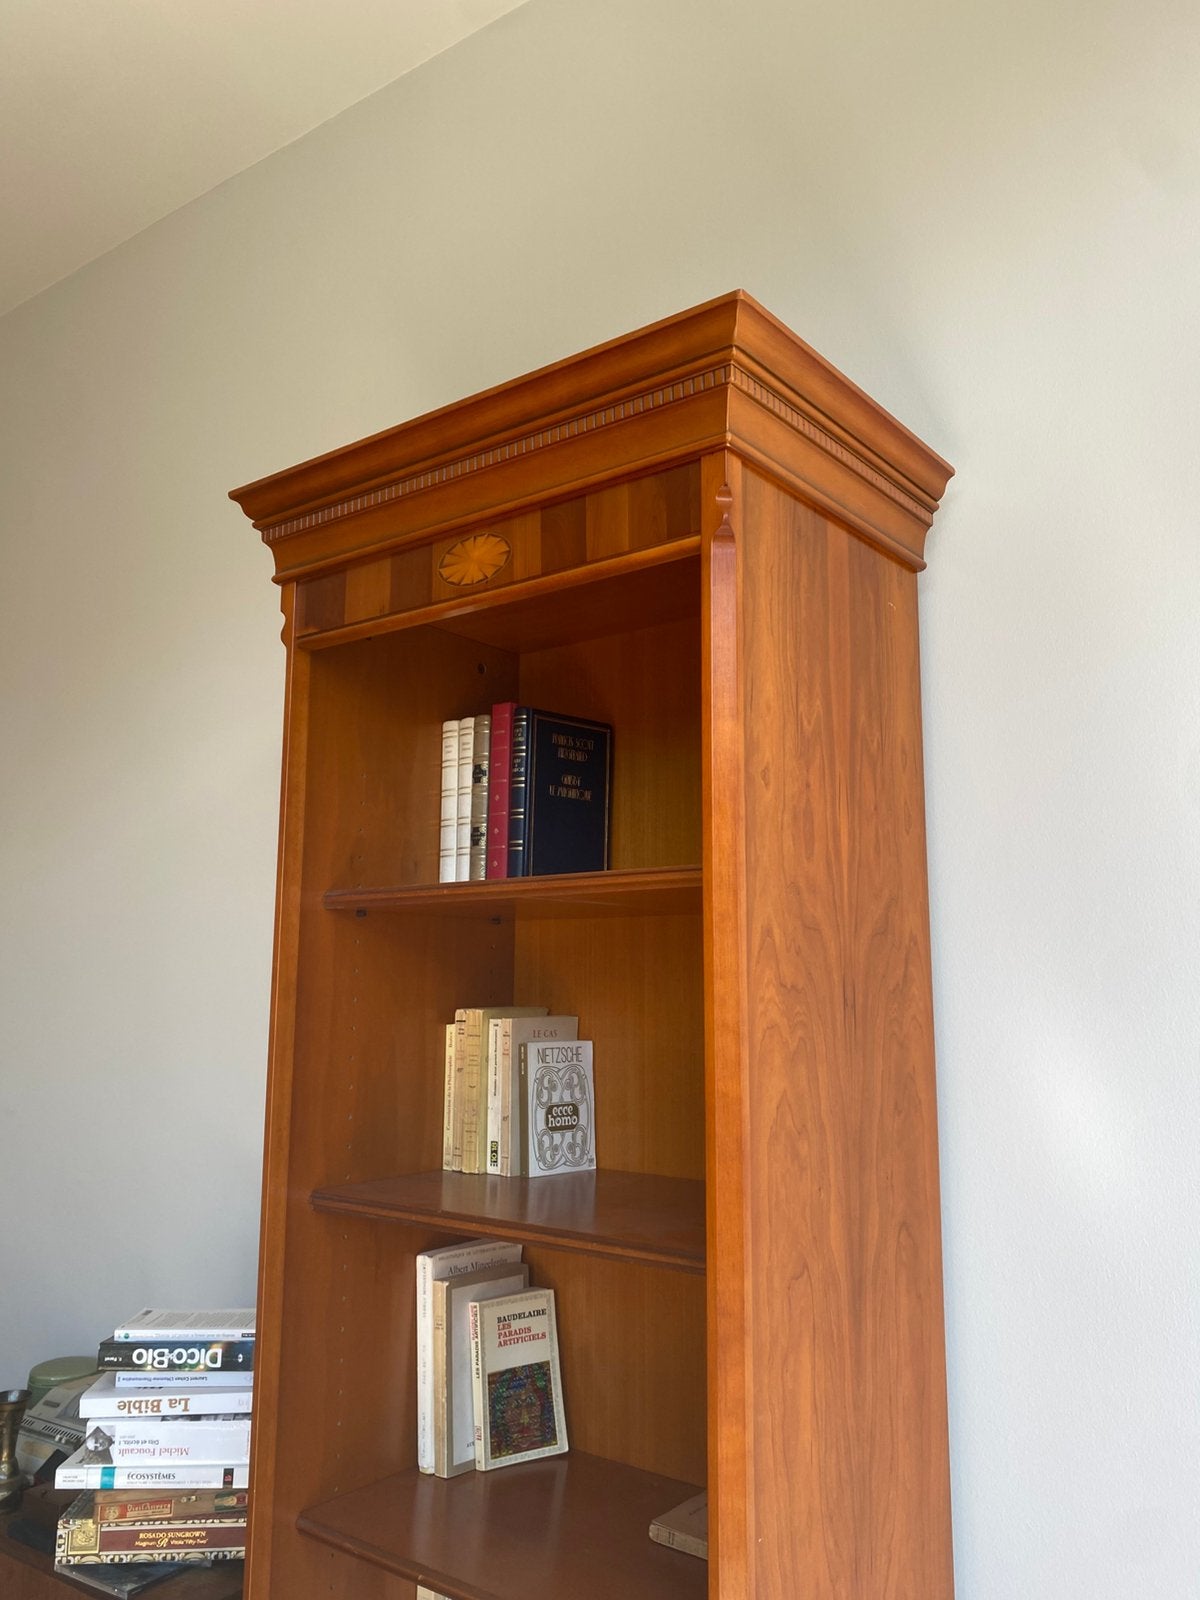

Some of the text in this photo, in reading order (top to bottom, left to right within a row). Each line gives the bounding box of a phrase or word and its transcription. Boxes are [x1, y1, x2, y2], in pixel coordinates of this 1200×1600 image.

[552, 1105, 574, 1116] ecce
[548, 1114, 578, 1127] homo
[448, 1262, 469, 1275] Albert
[497, 1308, 547, 1323] BAUDELAIRE
[497, 1322, 512, 1331] LES
[497, 1326, 532, 1339] PARADIS
[497, 1331, 547, 1348] ARTIFICIELS
[132, 1348, 169, 1369] Bio
[172, 1348, 222, 1368] Dico
[117, 1397, 190, 1414] La Bible
[118, 1447, 190, 1456] Michel Foucault
[127, 1472, 176, 1481] ÉCOSYSTÈMES
